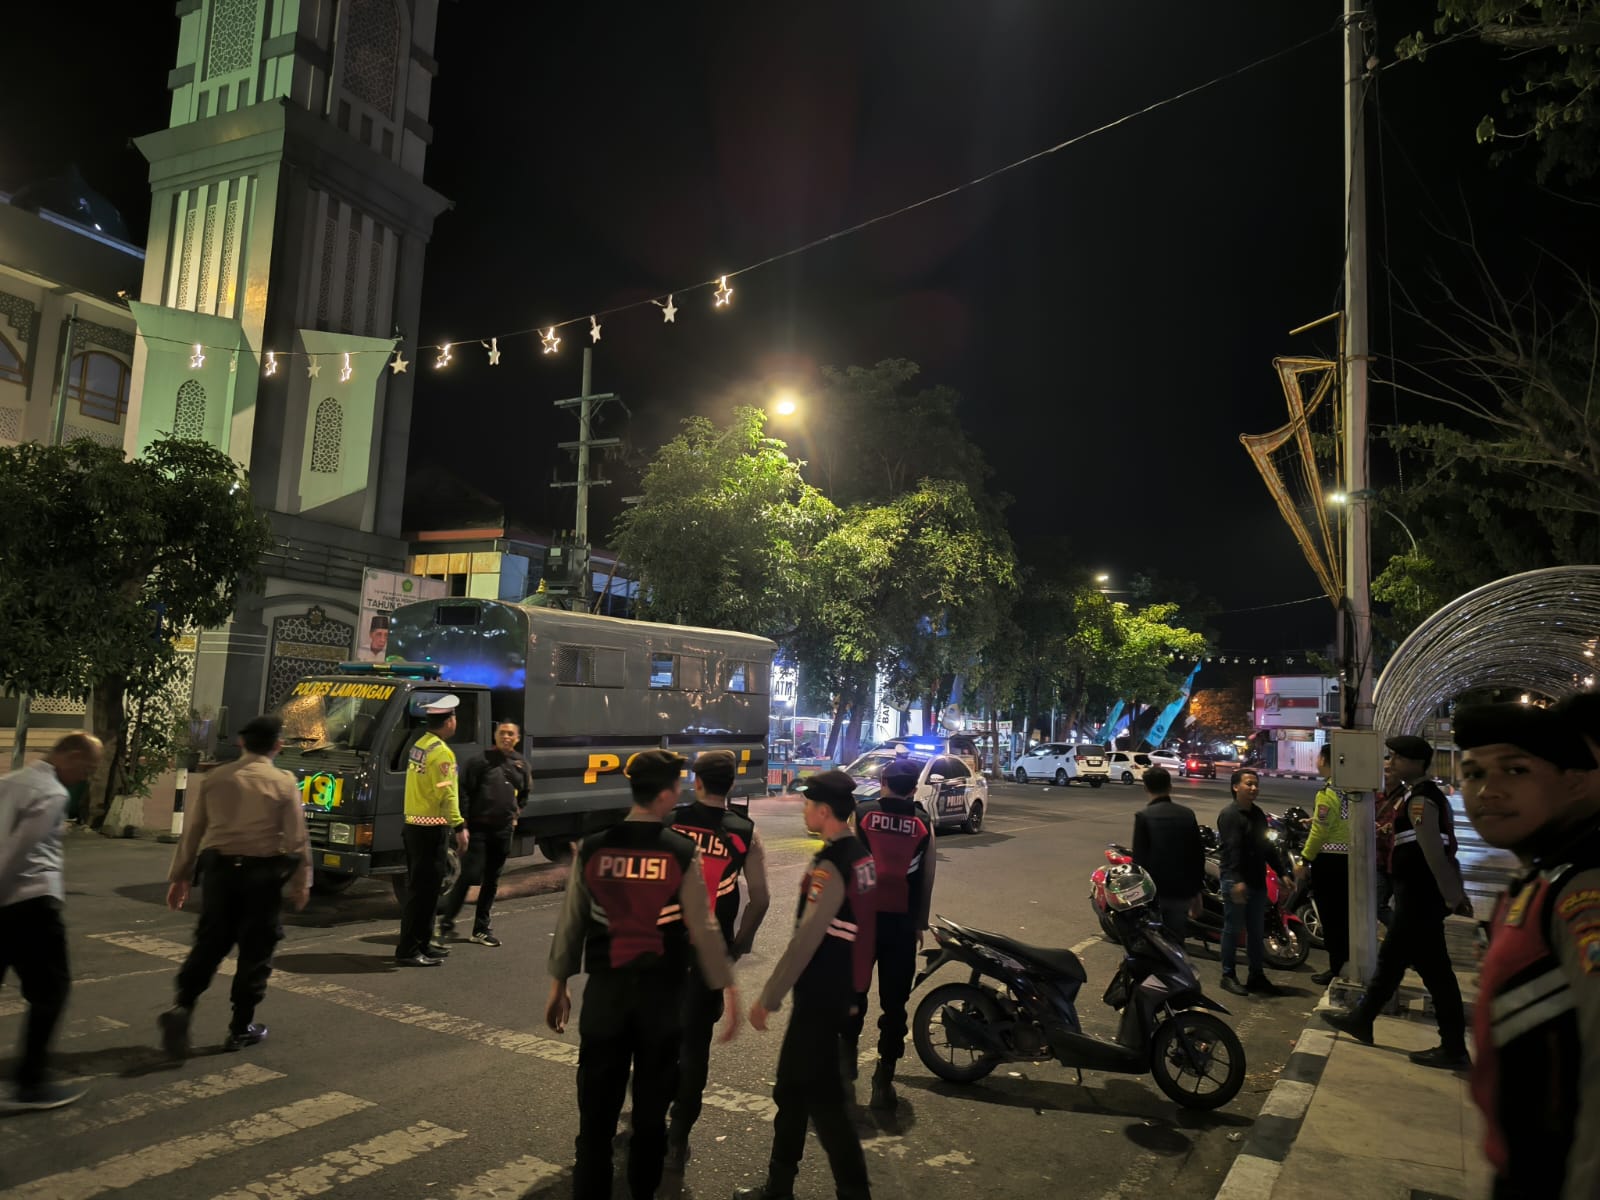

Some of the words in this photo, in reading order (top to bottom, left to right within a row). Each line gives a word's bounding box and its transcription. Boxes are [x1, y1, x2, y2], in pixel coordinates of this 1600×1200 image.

[367, 599, 396, 610] TAHUN
[291, 682, 333, 696] POLRES
[330, 683, 396, 700] LAMONGAN
[870, 814, 916, 835] POLISI
[597, 855, 668, 880] POLISI
